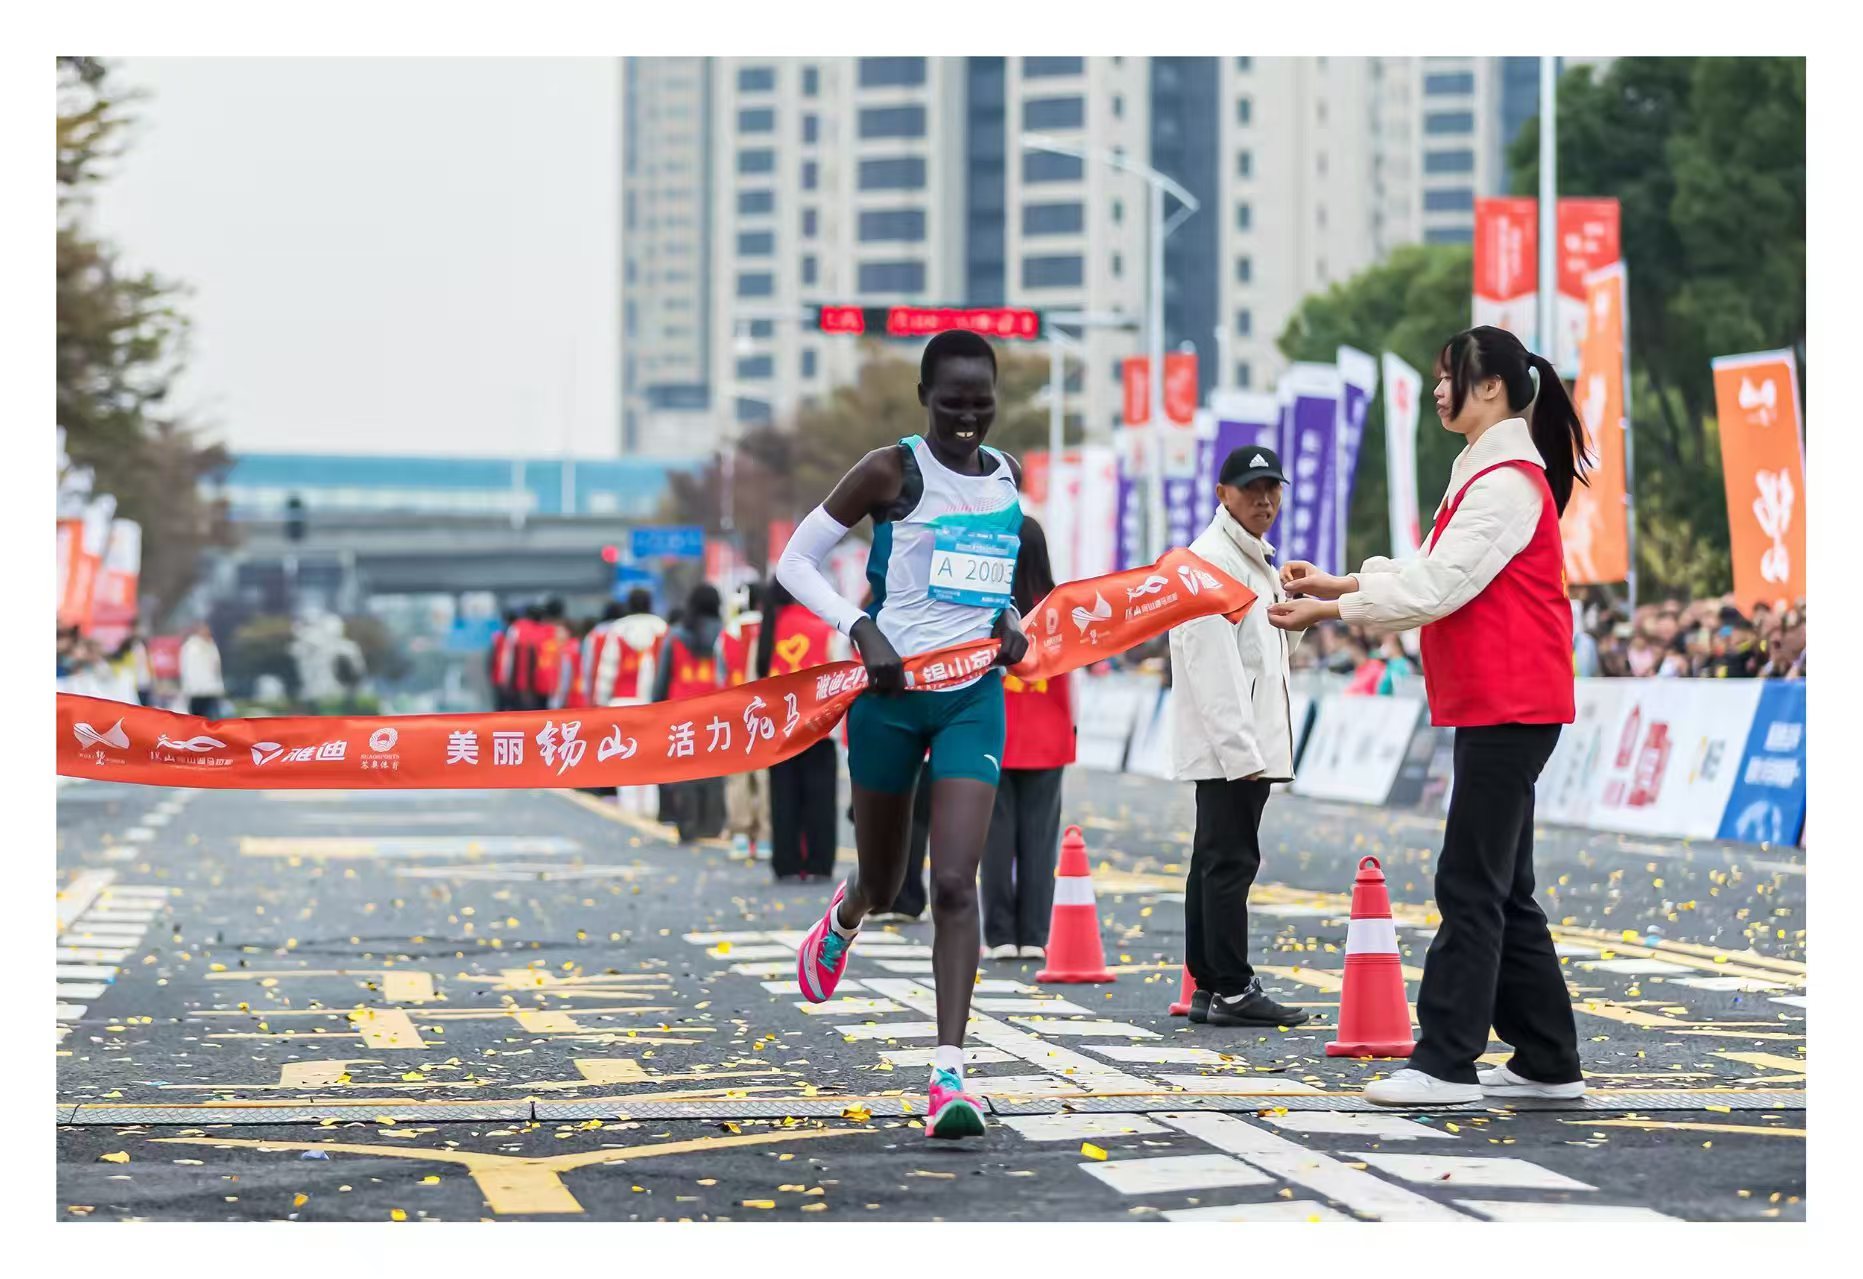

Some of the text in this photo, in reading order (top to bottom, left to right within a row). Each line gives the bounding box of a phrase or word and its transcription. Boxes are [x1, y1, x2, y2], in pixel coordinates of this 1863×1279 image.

[937, 556, 953, 578] A
[446, 720, 638, 776] 美丽锡山
[667, 691, 800, 758] 活力宛马
[280, 740, 349, 763] 雅迪
